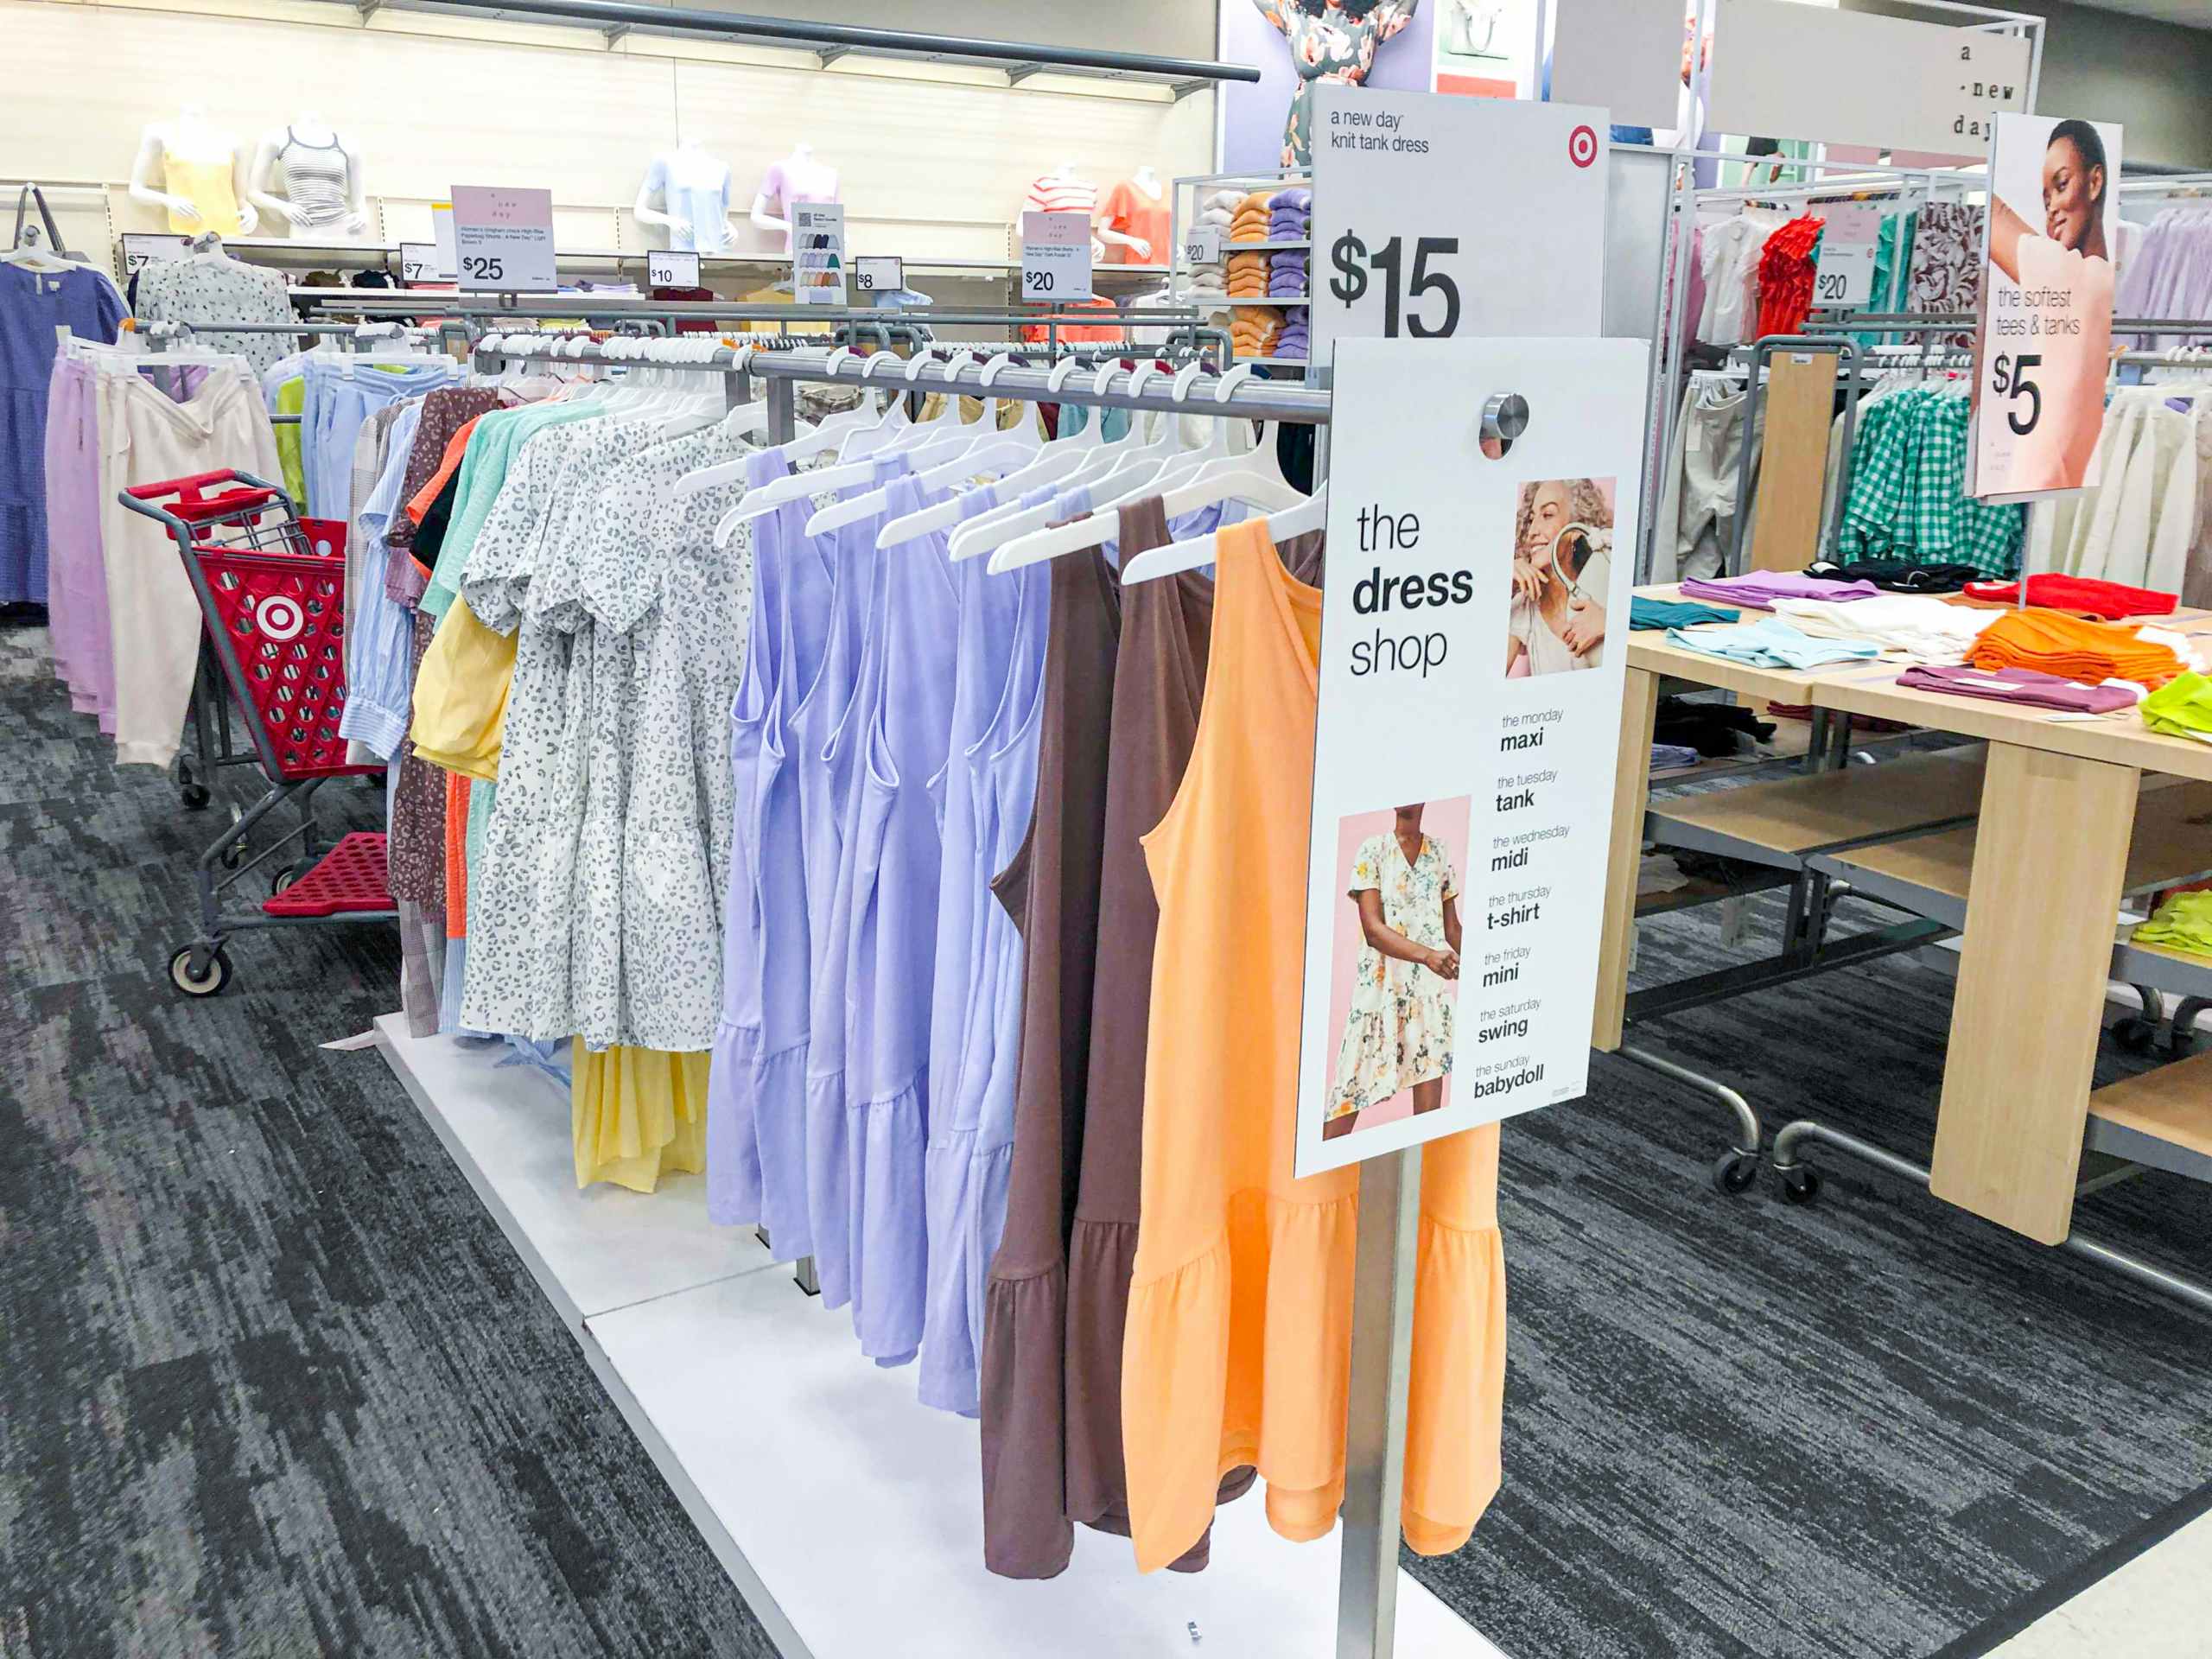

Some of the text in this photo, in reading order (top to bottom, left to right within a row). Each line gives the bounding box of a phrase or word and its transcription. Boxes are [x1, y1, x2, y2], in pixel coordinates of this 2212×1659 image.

[1961, 46, 1971, 60] a
[1973, 82, 2014, 99] new
[1331, 111, 1340, 124] a
[1344, 111, 1372, 126] new
[1332, 131, 1429, 153] knit tank dress
[1187, 245, 1204, 261] $20
[404, 263, 423, 279] $7
[463, 256, 503, 280] $25
[652, 270, 672, 283] $10
[858, 273, 873, 289] $8
[1026, 270, 1054, 291] $20
[1330, 229, 1460, 338] $15
[1818, 274, 1847, 300] $20
[1998, 286, 2071, 307] the softest
[1997, 314, 2081, 335] tees & tanks
[1993, 350, 2042, 435] $5
[1357, 504, 1420, 552] the
[1352, 566, 1473, 615] dress
[1351, 627, 1447, 678] shop
[1502, 708, 1564, 728] the monday
[1500, 727, 1544, 752] maxi
[1497, 768, 1559, 790] the tuesday
[1495, 788, 1535, 812] tank
[1492, 823, 1571, 849] the wednesday
[1491, 847, 1529, 872] midi
[1488, 883, 1552, 908] the thursday
[1487, 902, 1540, 930] t-shirt
[1484, 945, 1531, 966] the friday
[1482, 962, 1520, 988] mini
[1479, 997, 1541, 1022] the saturday
[1478, 1017, 1529, 1044] swing
[1475, 1053, 1530, 1078] the sunday
[1473, 1063, 1544, 1099] babydoll
